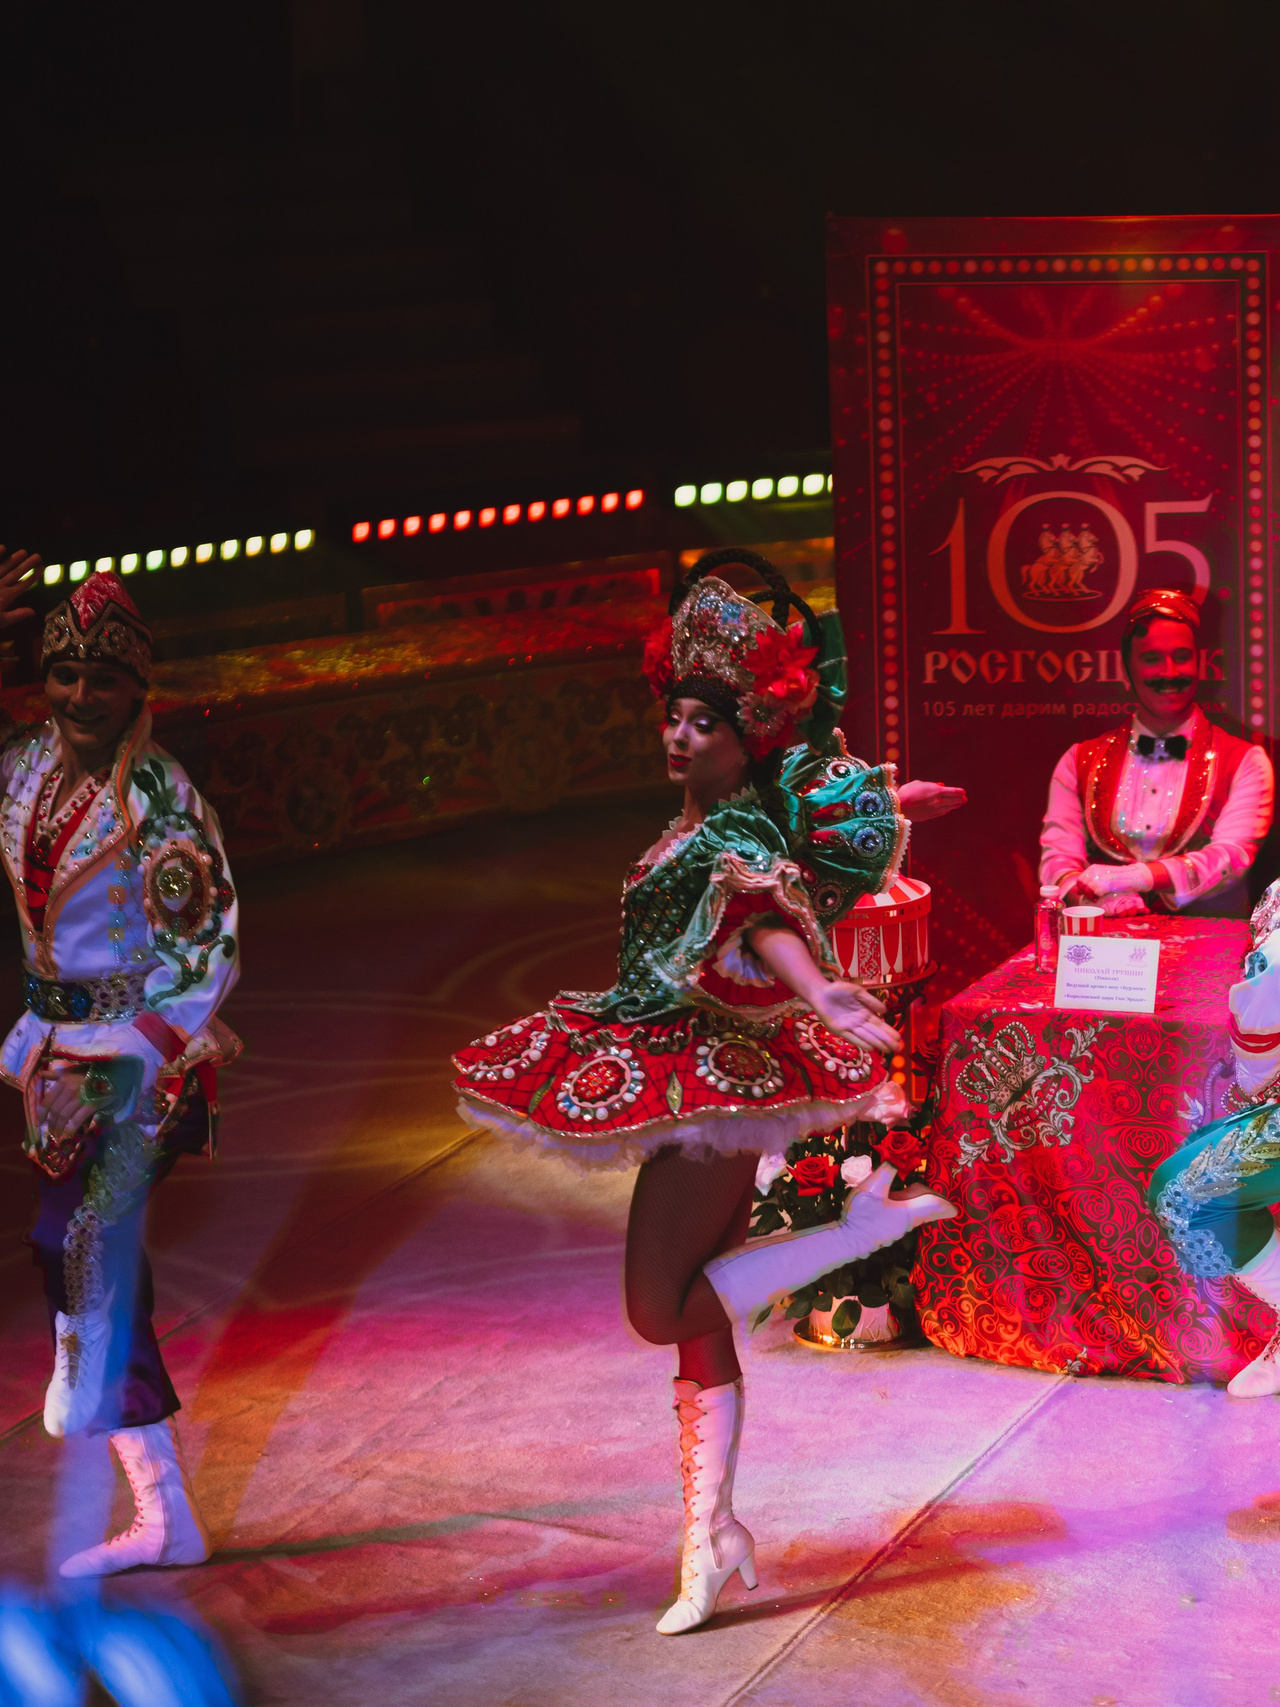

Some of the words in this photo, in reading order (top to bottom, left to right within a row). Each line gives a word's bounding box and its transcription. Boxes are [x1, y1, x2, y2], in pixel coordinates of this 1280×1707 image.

[929, 490, 1214, 634] 105
[922, 649, 1227, 691] РОСГОСЦК
[922, 701, 956, 717] 105
[962, 703, 995, 717] лет
[1001, 703, 1066, 718] дарим
[1072, 702, 1140, 719] радос
[1074, 967, 1110, 975] НИКОЛАЙ
[1014, 1116, 1031, 1127] ГИИ
[1035, 1082, 1058, 1115] ЭРАДЗЕ
